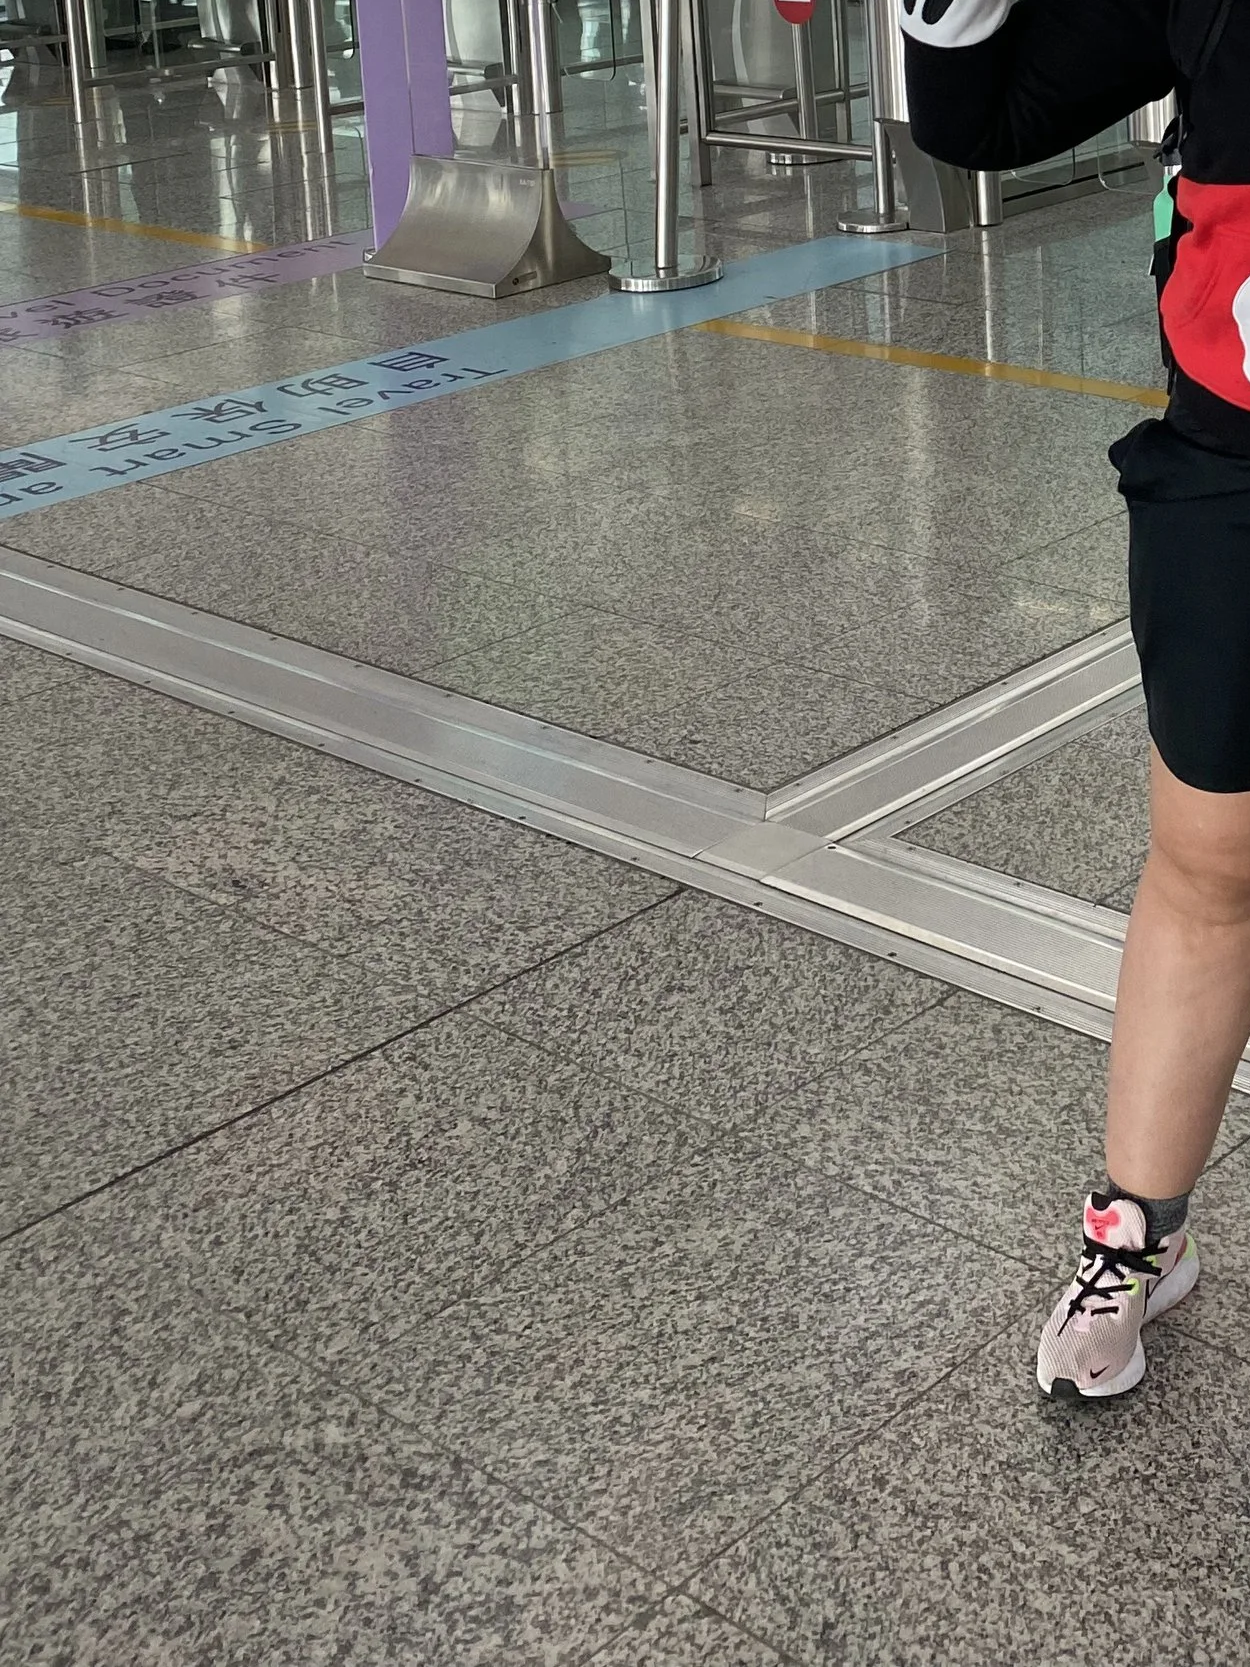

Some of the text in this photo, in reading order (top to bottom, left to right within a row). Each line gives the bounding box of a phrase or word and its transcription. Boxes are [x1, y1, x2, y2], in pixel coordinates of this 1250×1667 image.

[90, 240, 357, 297] Document
[317, 366, 510, 416] Travel
[88, 418, 302, 477] Smart
